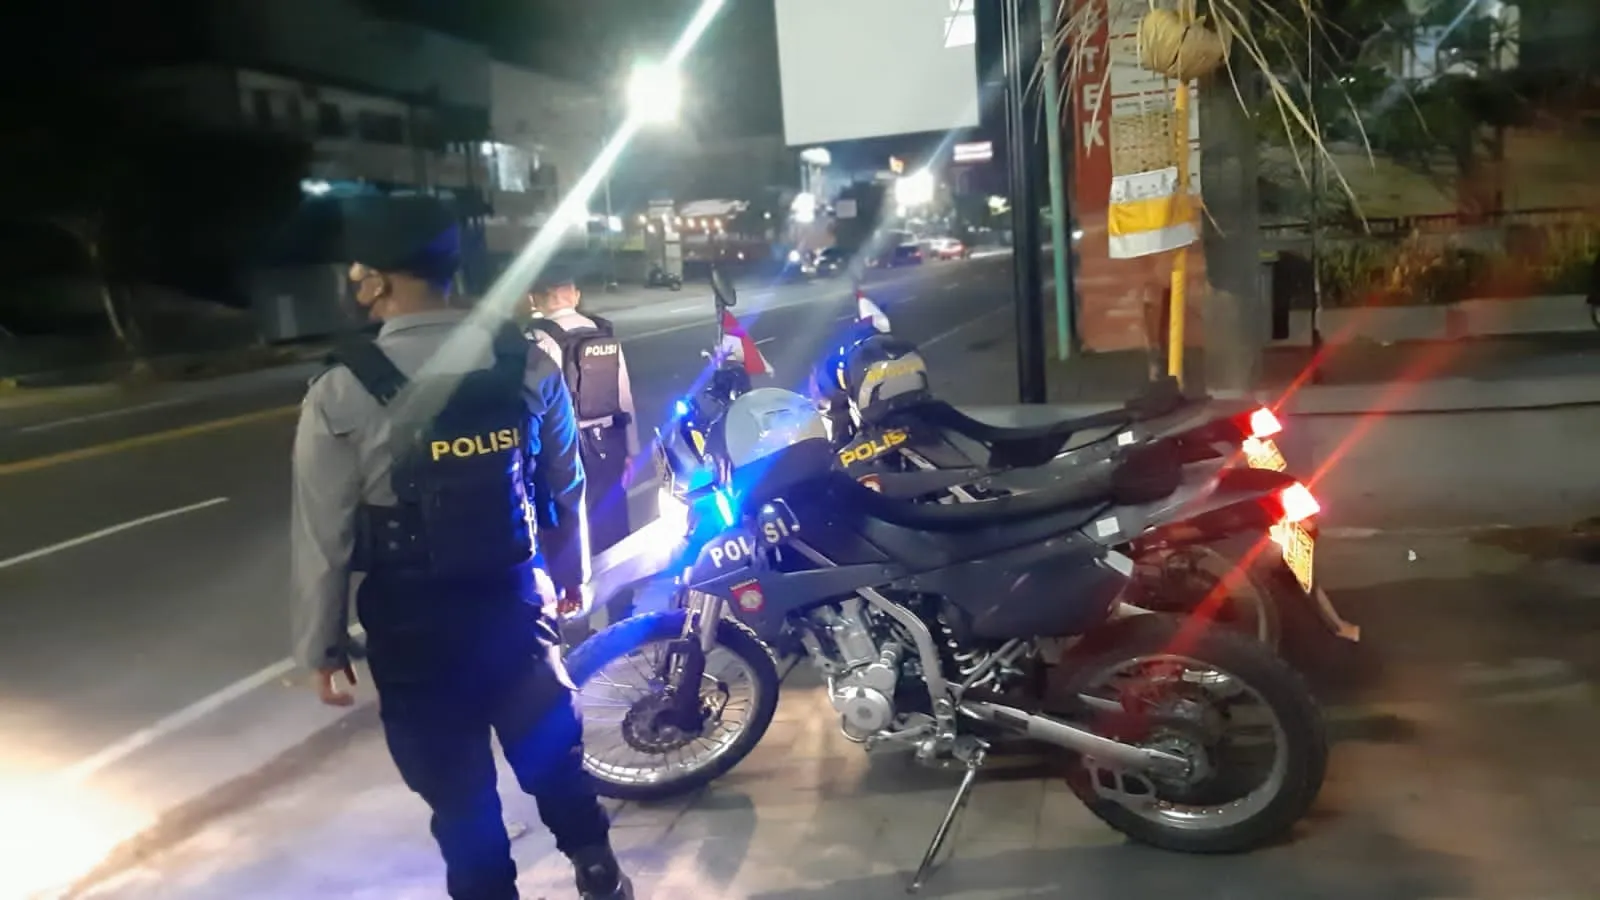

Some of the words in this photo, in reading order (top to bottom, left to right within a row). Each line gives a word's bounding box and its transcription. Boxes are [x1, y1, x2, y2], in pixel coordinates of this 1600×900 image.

[585, 343, 618, 357] POLISI
[431, 427, 519, 462] POLISI
[709, 518, 790, 568] POLSI
